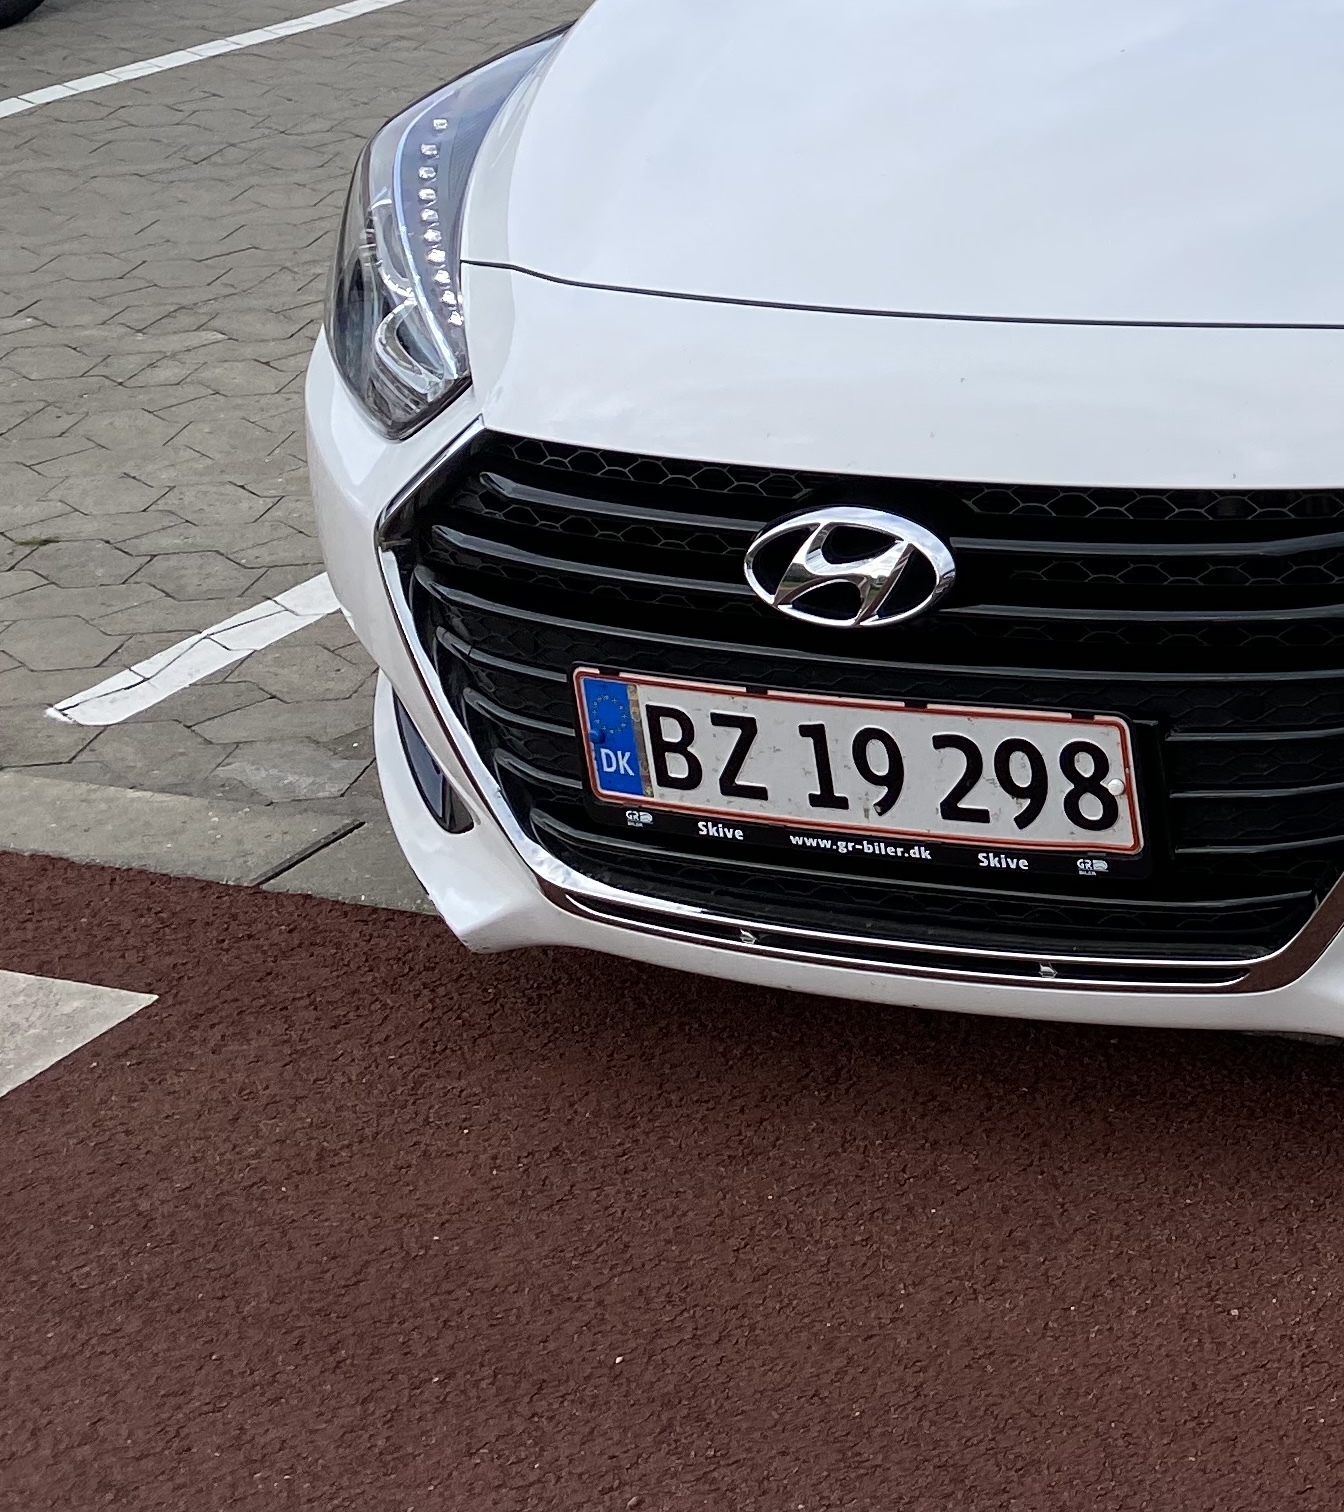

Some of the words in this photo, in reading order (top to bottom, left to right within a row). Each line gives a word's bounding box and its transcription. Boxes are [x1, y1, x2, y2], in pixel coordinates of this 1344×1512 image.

[600, 747, 635, 777] DK
[645, 703, 768, 801] BZ
[798, 722, 904, 817] 19
[931, 732, 1119, 832] 298
[697, 821, 744, 841] Skive
[789, 834, 932, 860] www.gr-biler.dk
[977, 852, 1029, 870] Skive
